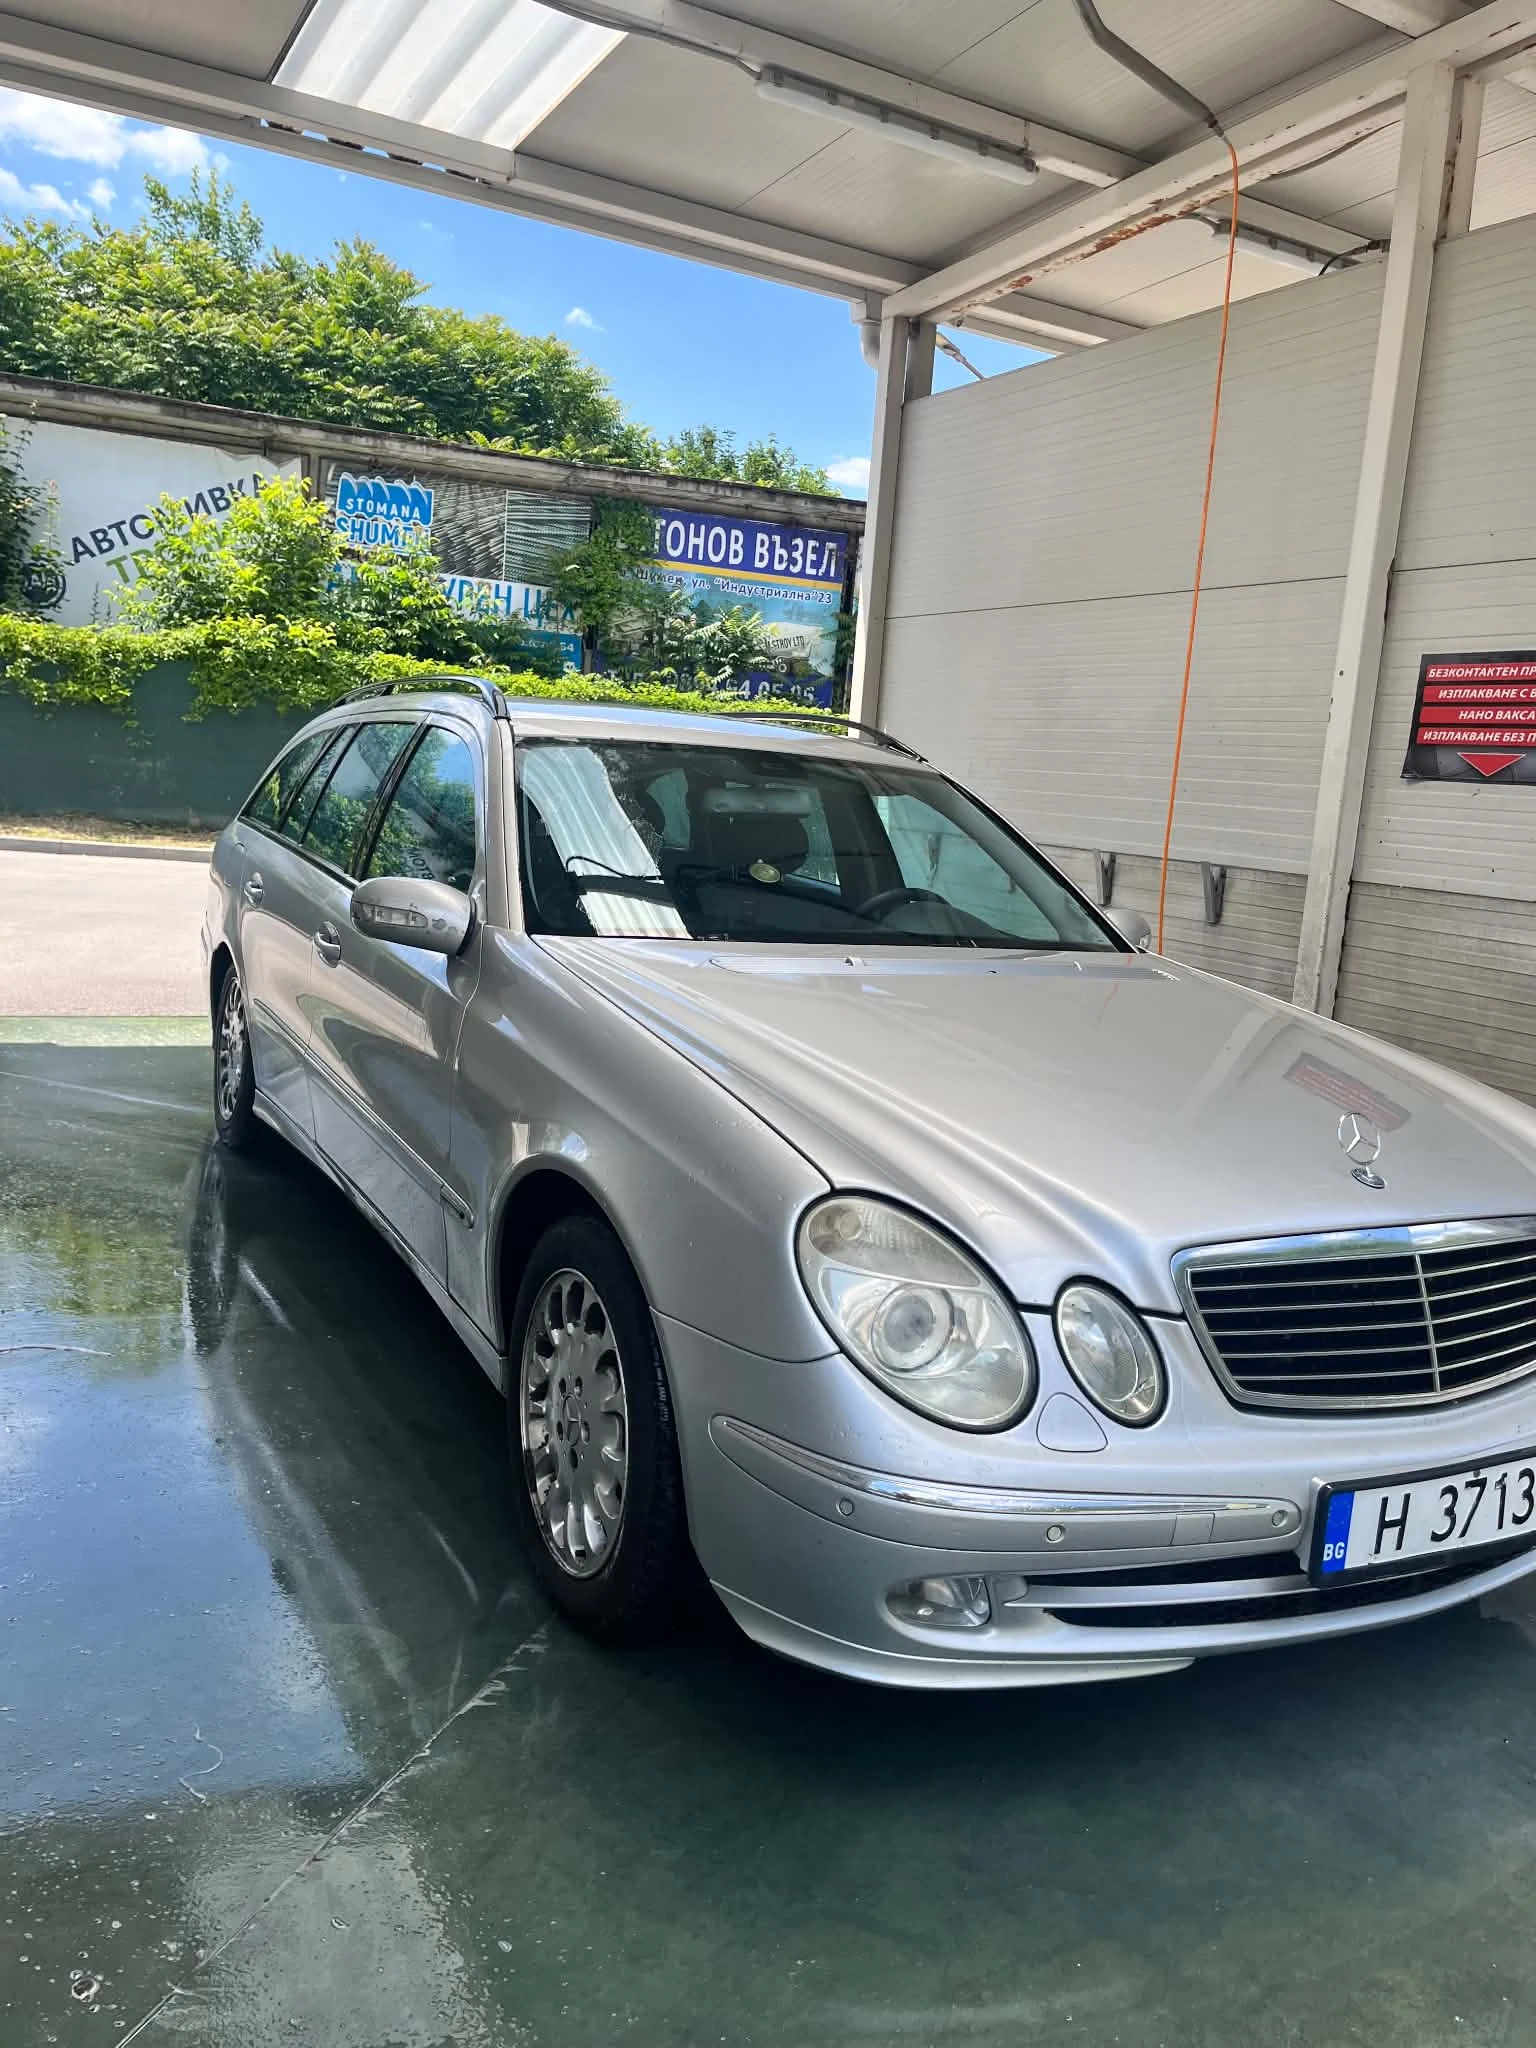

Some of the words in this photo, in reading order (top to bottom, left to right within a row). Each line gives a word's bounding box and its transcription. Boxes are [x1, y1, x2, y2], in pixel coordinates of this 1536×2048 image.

[345, 498, 421, 519] STOMANA
[754, 532, 838, 577] ВЪЗЕЛ
[692, 577, 710, 590] ул.
[1428, 667, 1518, 678] БЕЗКОНТАКТЕН
[1438, 688, 1518, 699] ИЗПЛАКВАНЕ
[1458, 710, 1493, 720] НАНО
[1423, 731, 1501, 742] ИЗПЛАКВАНЕ
[1502, 732, 1525, 742] БЕЗ
[1374, 1492, 1411, 1555] H
[1430, 1467, 1535, 1542] 3713
[1323, 1542, 1346, 1561] BG
